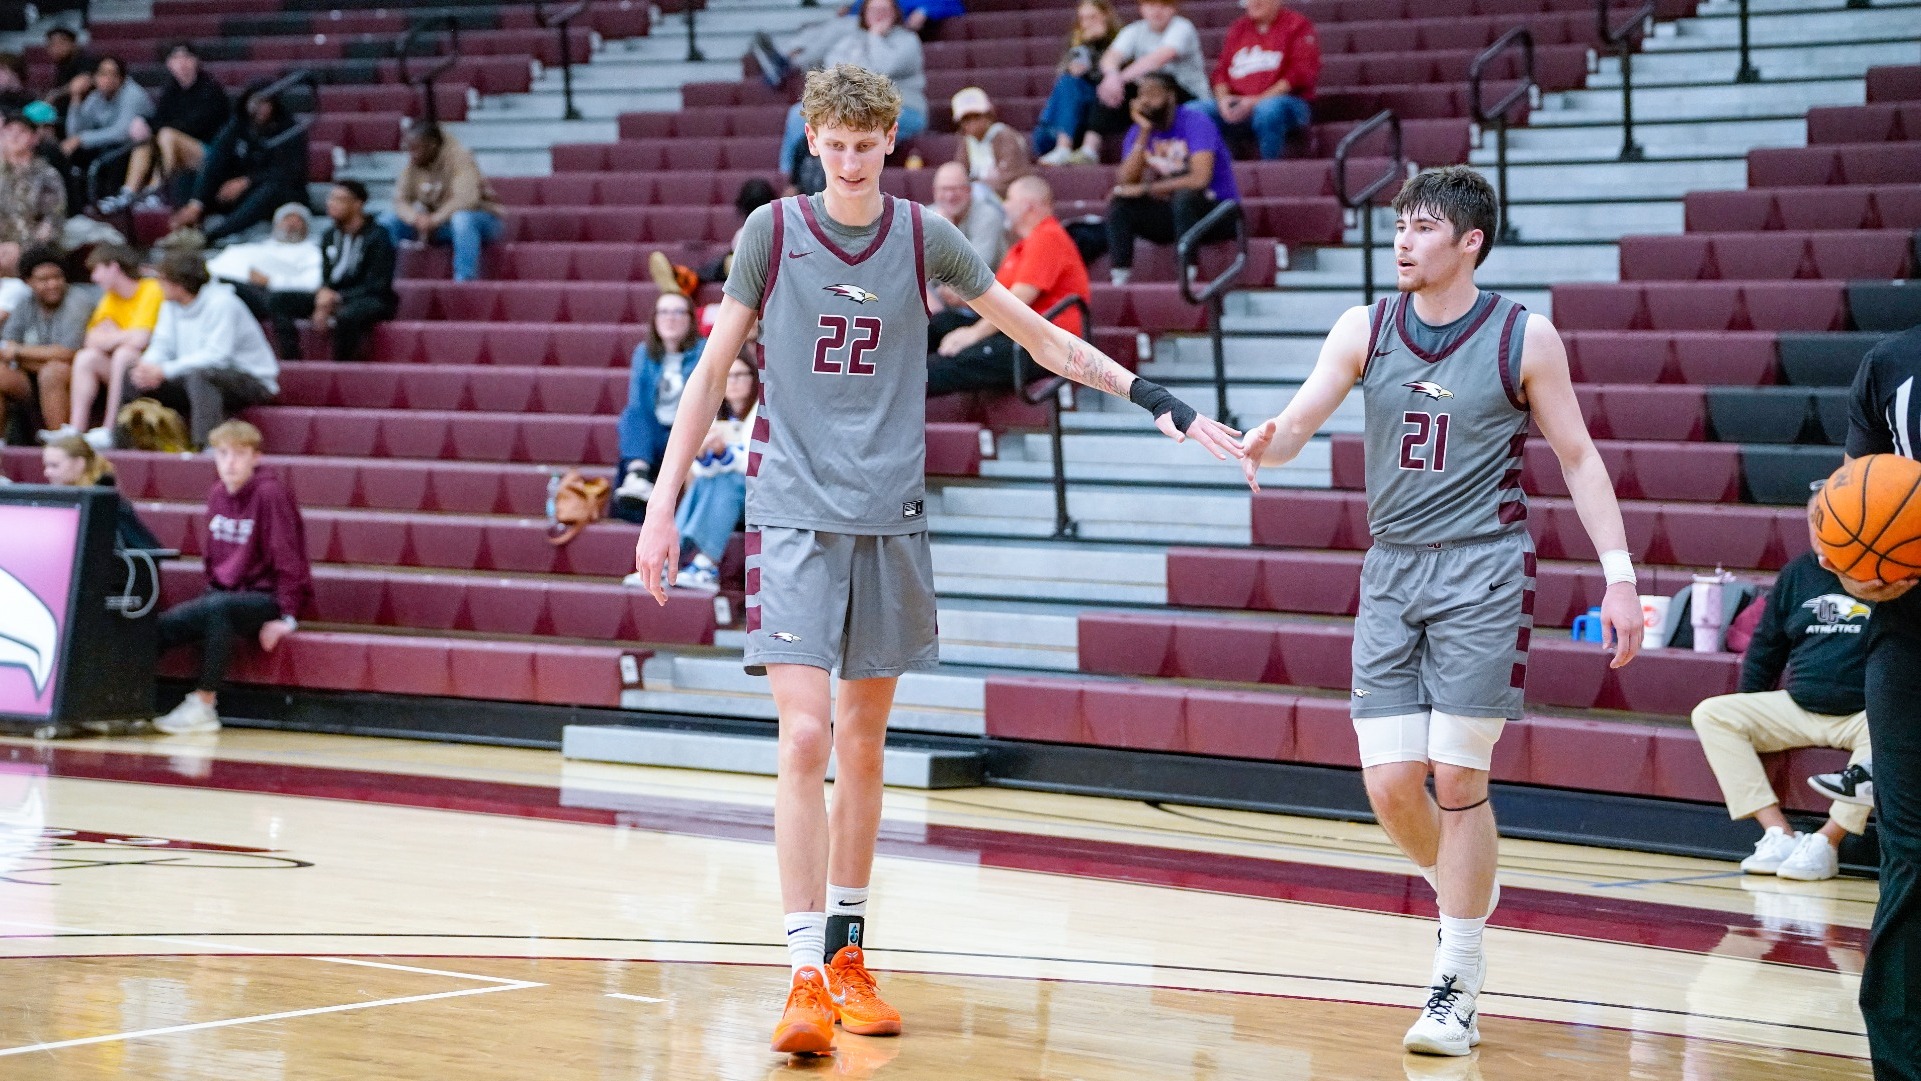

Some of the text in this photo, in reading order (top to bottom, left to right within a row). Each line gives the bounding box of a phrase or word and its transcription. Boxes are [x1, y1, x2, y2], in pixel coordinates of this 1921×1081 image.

[812, 314, 882, 376] 22
[1399, 411, 1450, 472] 21
[1805, 624, 1861, 634] ATHLETICS
[1817, 599, 1839, 625] UC
